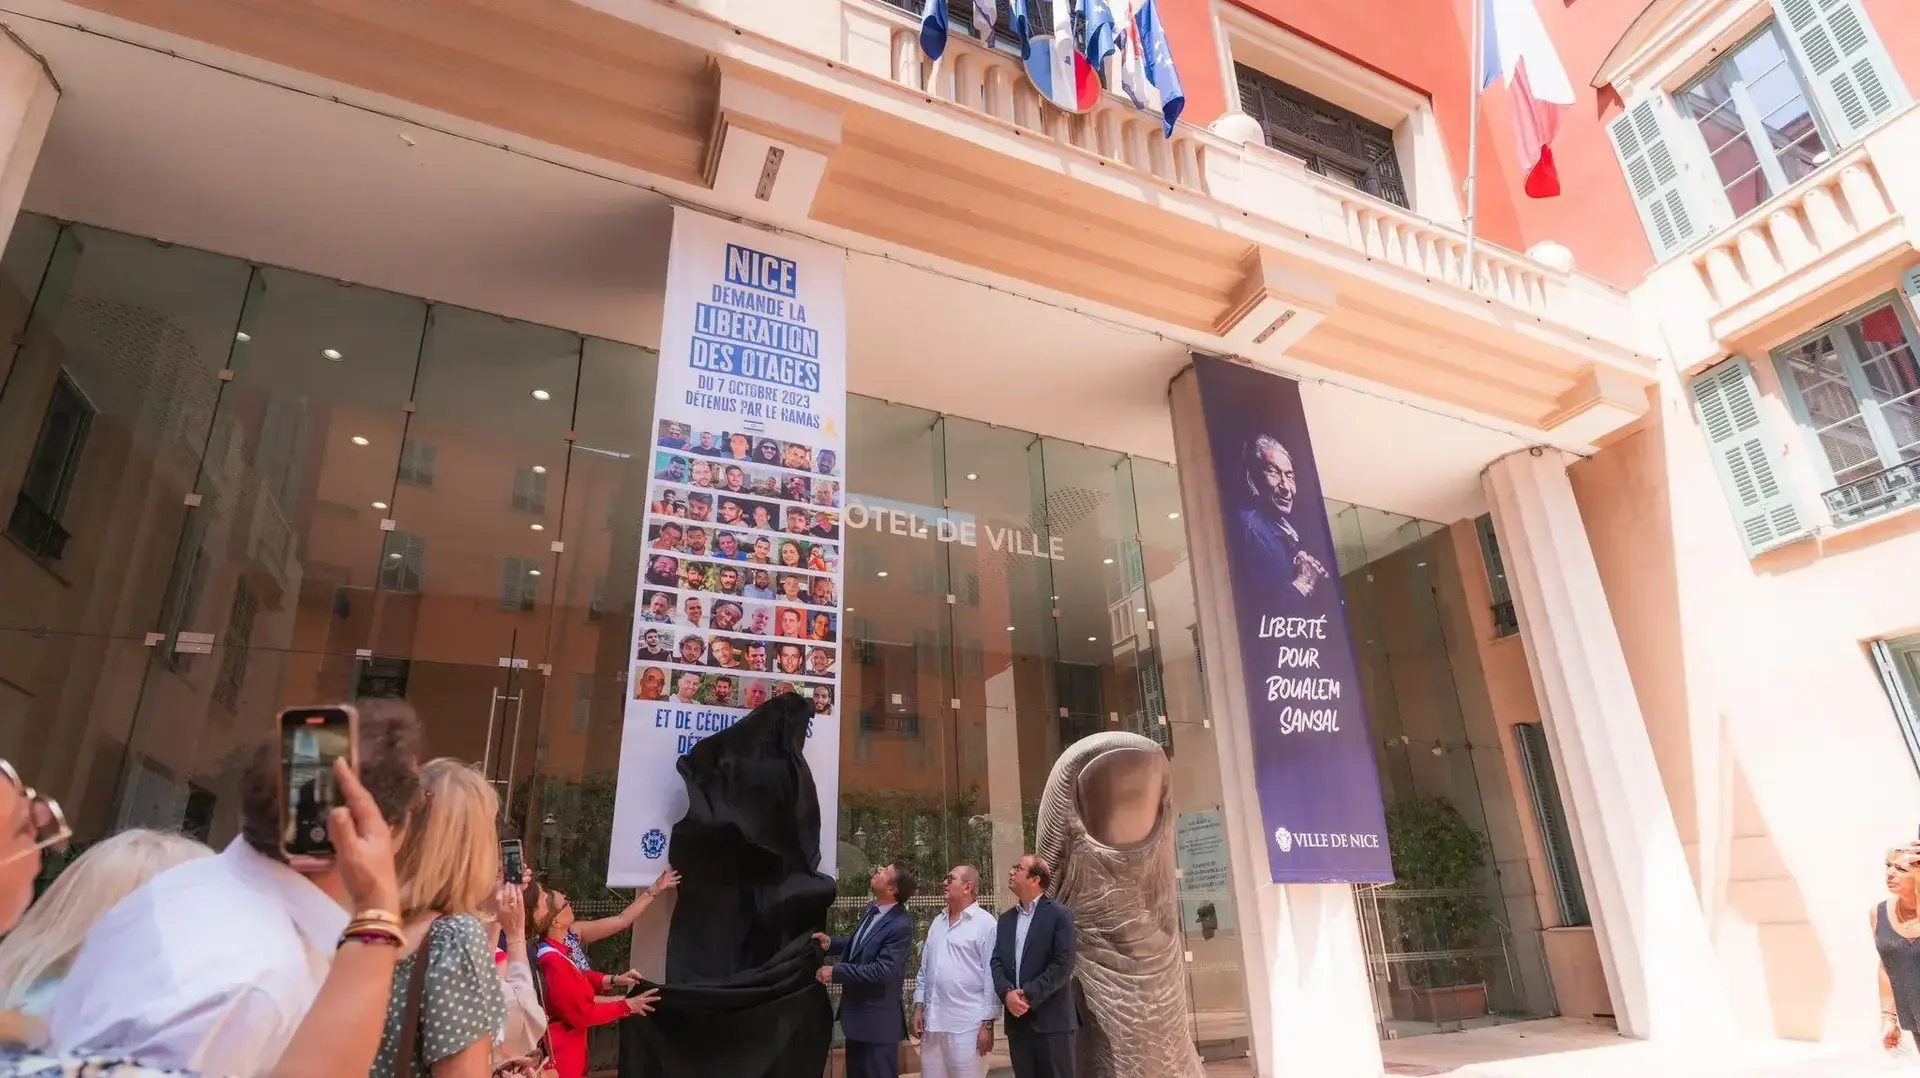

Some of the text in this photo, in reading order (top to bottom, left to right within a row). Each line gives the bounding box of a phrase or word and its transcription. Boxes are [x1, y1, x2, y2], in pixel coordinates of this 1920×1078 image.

[729, 247, 795, 295] NICE
[712, 284, 806, 323] DEMANDE LA
[692, 339, 818, 390] DES OTAGES
[698, 375, 810, 408] DU 7 OCTOBRE 2023
[686, 389, 820, 429] DÉTENUS PAR LE HAMAS
[844, 500, 1065, 561] ÔTEL DE VILLE
[1258, 614, 1327, 640] LIBERTÉ
[1278, 646, 1320, 669] POUR
[1266, 675, 1340, 701] BOUALEM
[656, 709, 672, 728] ET
[676, 711, 692, 730] DE
[1279, 706, 1340, 734] SANSAL
[1292, 833, 1379, 848] VILLE DE NICE
